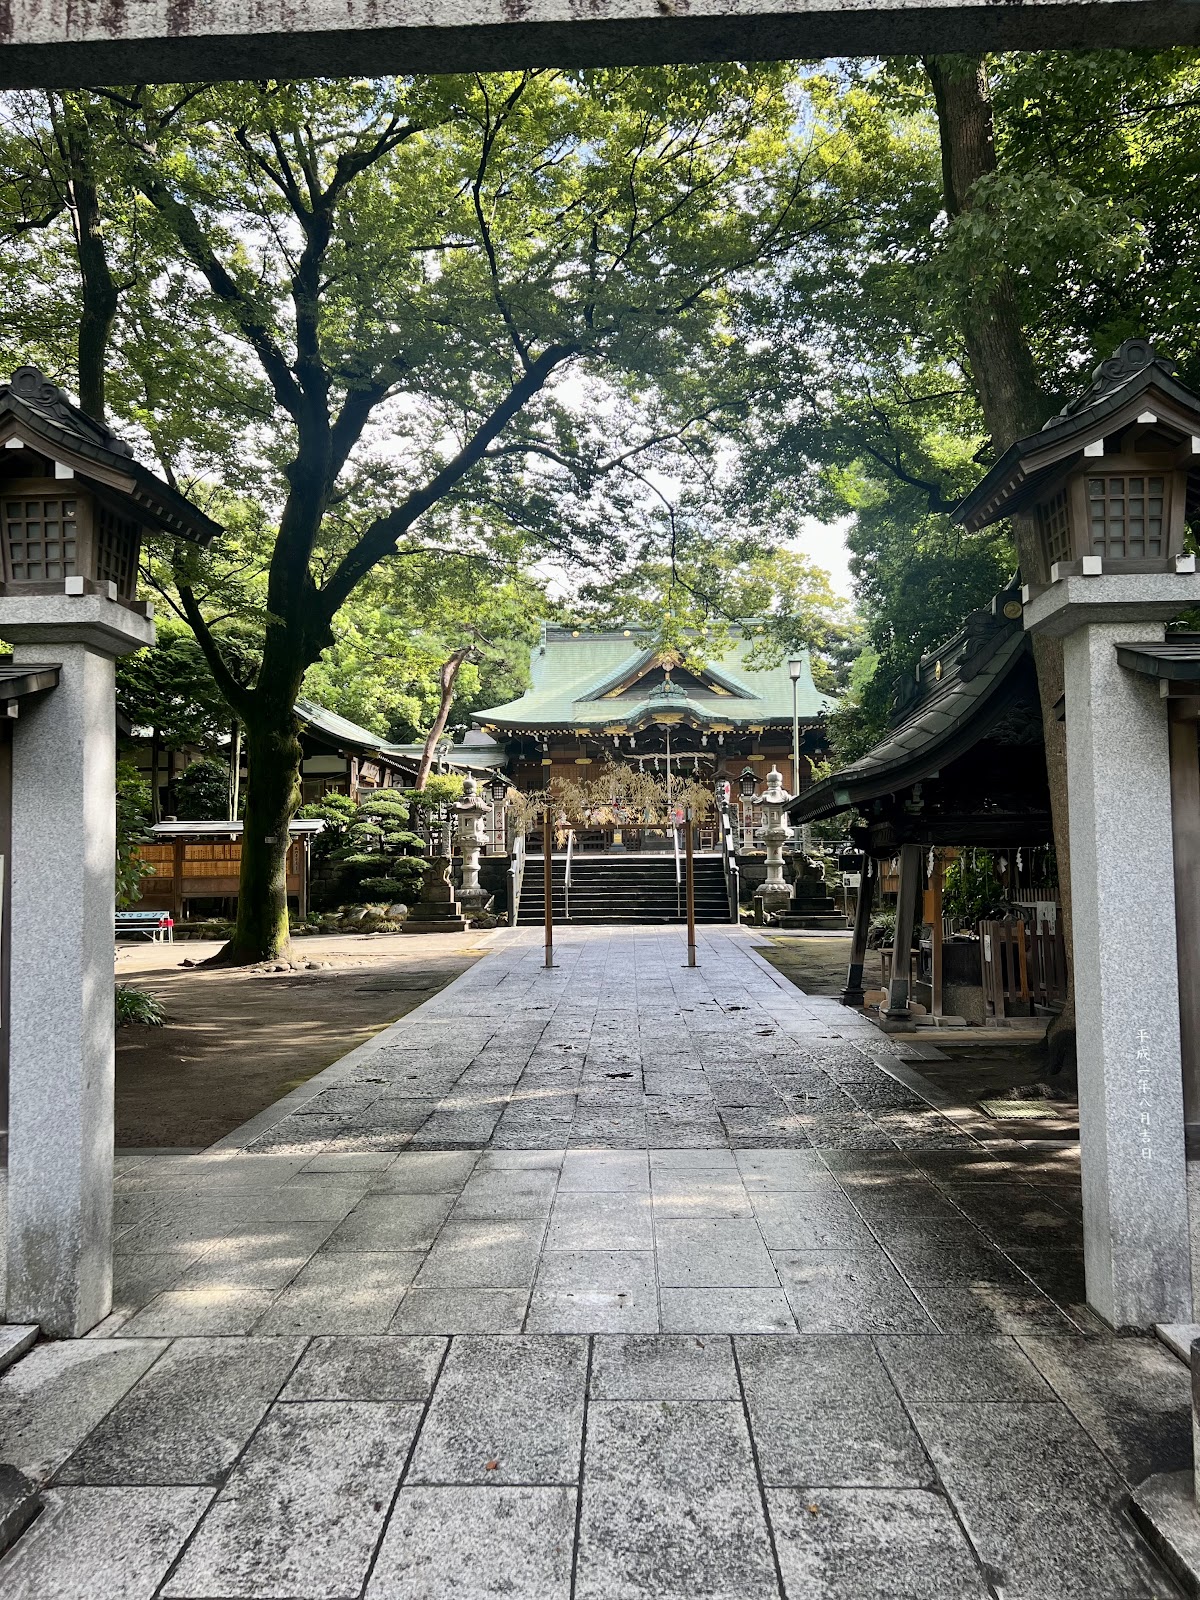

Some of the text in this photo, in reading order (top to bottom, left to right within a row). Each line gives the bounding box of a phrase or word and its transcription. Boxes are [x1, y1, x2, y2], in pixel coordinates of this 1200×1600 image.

[1136, 1029, 1152, 1160] 平成二年八月吉日
